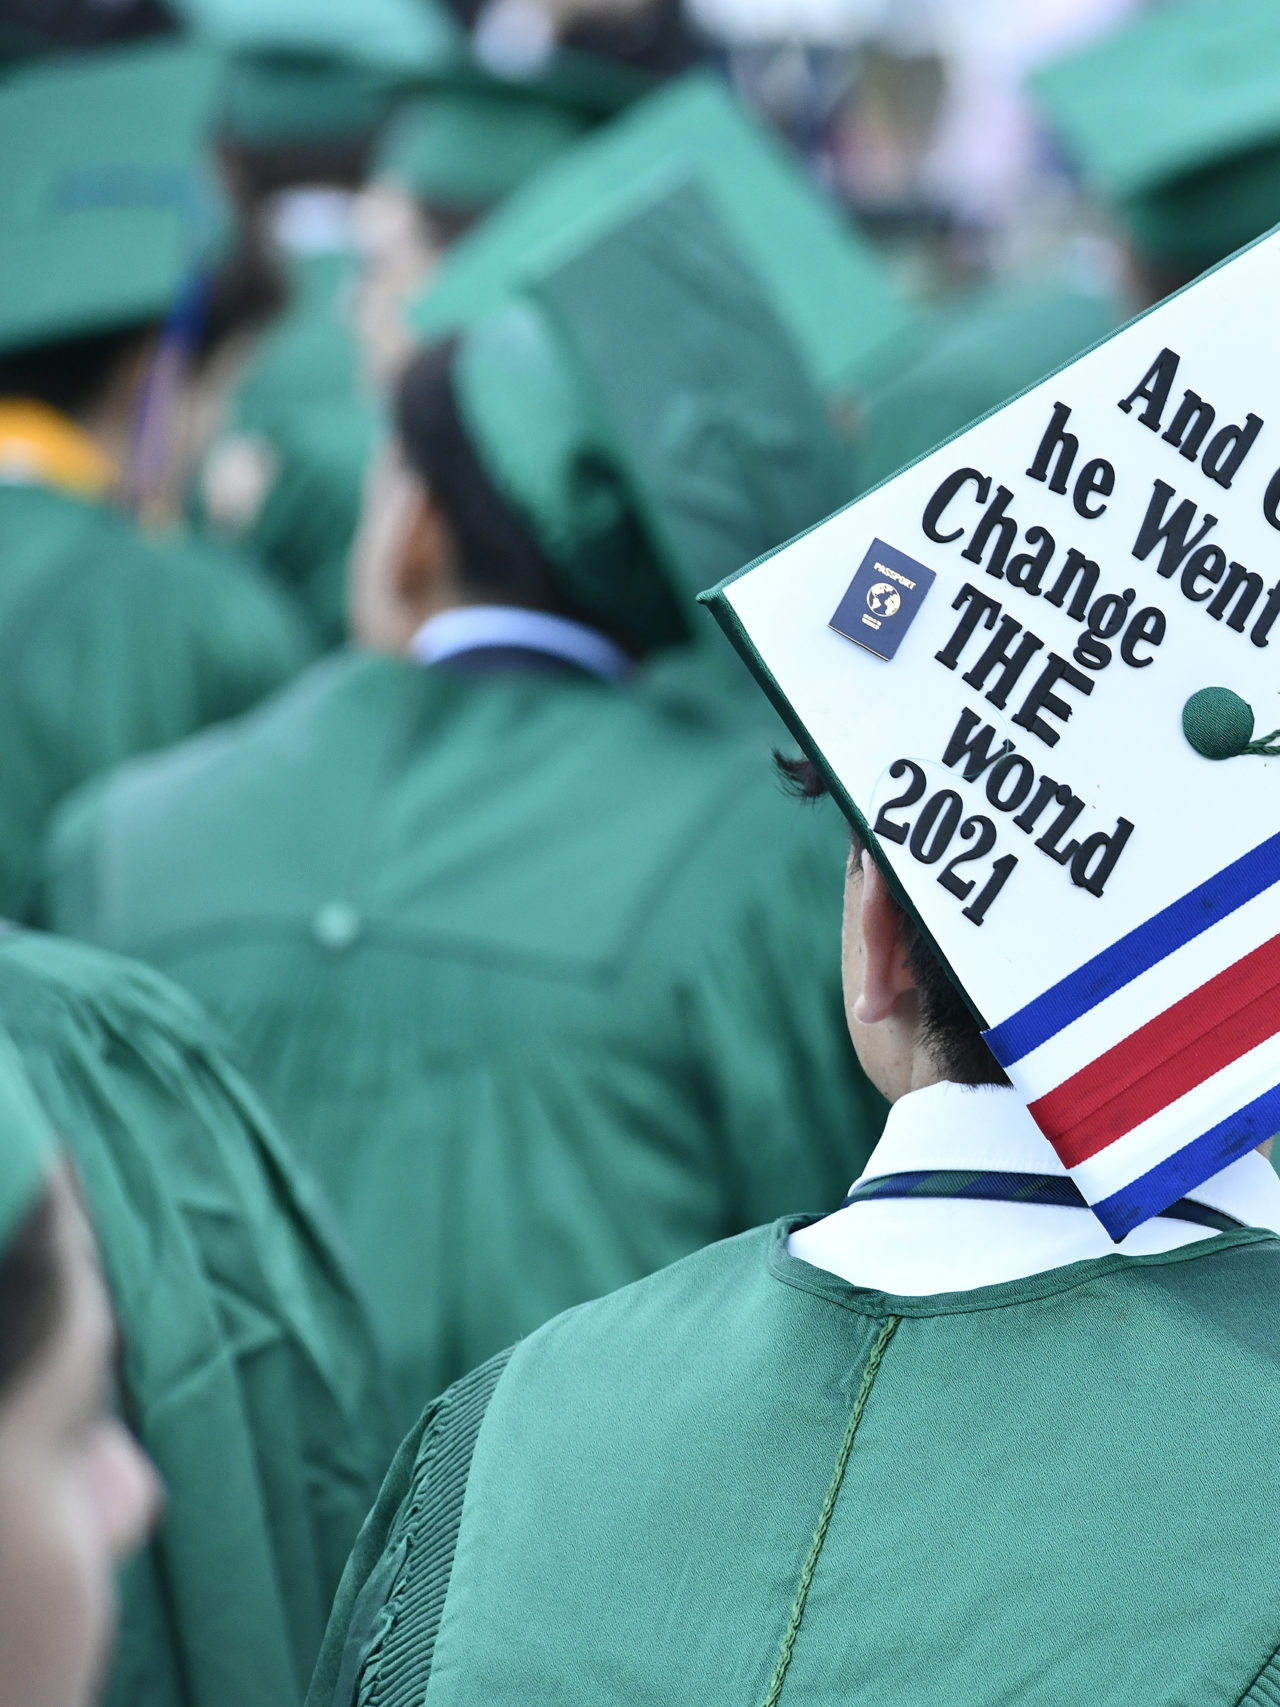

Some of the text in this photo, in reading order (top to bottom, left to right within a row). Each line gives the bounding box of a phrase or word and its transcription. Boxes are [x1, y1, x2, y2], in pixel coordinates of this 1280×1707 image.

[1026, 402, 1115, 519] he
[1118, 348, 1263, 489] And
[873, 561, 916, 590] PASSPORT
[923, 468, 1166, 670] Change
[935, 583, 1094, 748] THE
[873, 759, 1018, 926] 2021
